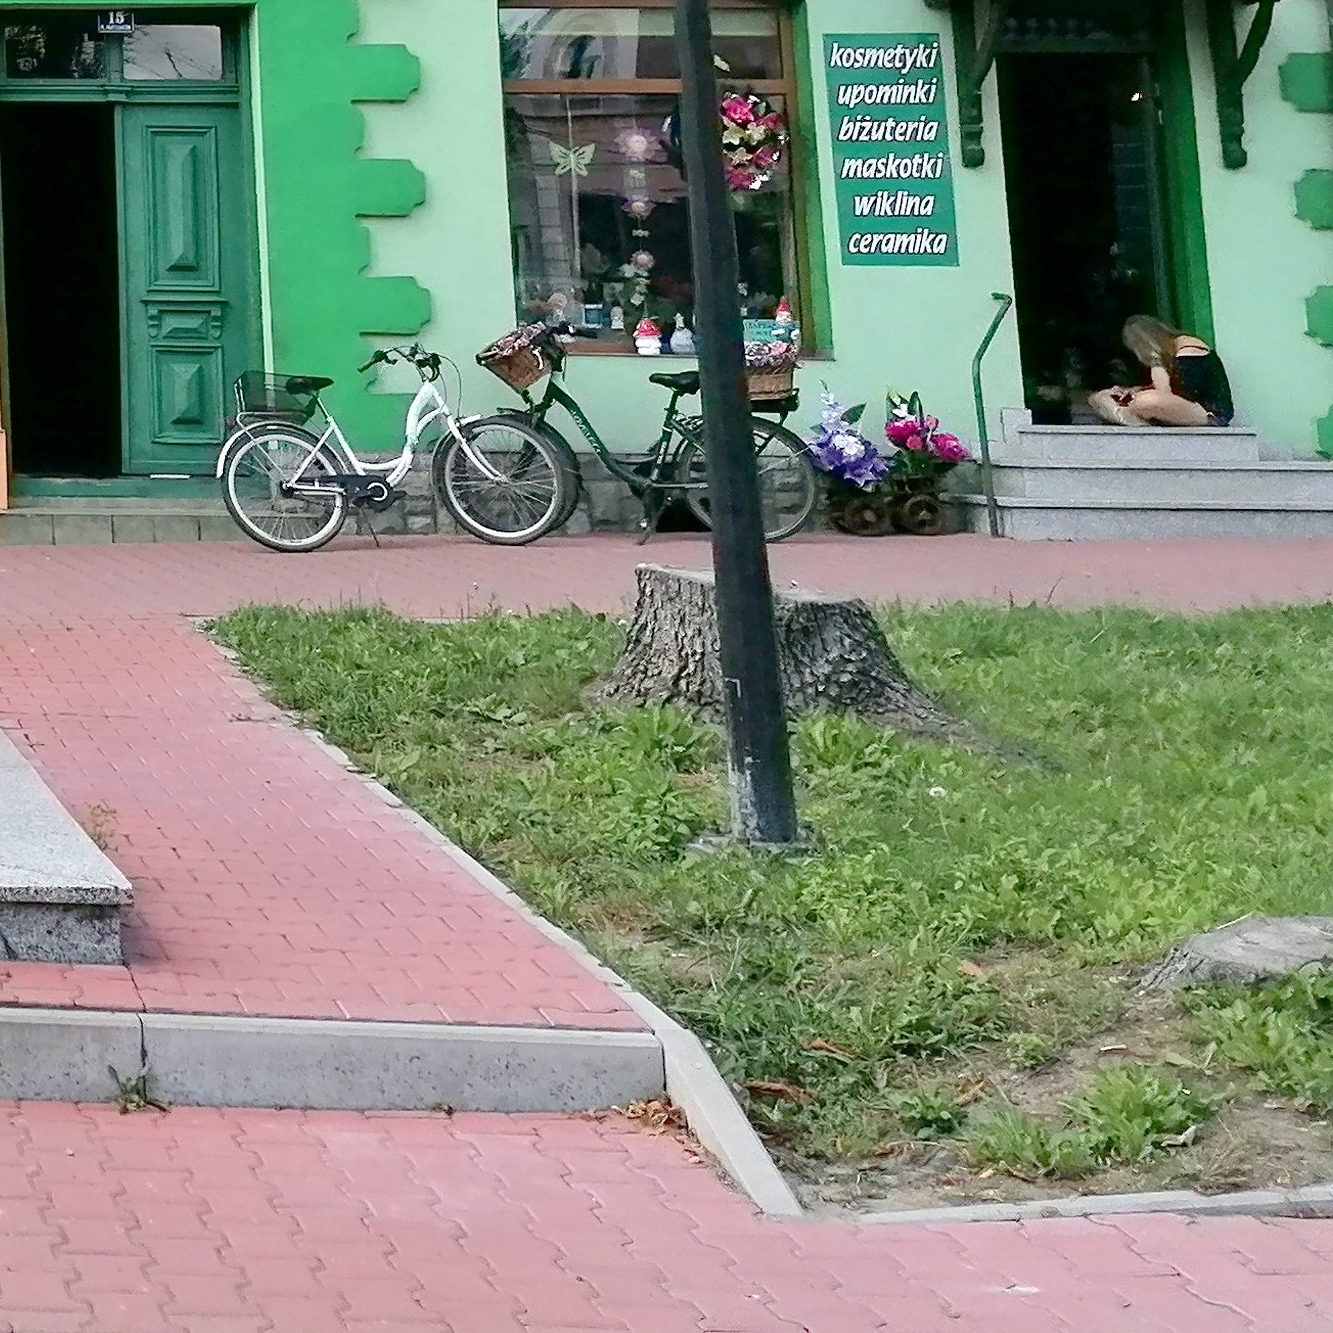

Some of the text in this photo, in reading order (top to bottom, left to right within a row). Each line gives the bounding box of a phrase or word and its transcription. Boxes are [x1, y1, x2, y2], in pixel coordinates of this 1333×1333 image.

[830, 42, 938, 74] kosmetyki
[837, 78, 937, 108] upominki
[838, 115, 938, 141] biżuteria
[841, 152, 943, 178] maskotki
[854, 190, 935, 216] wiklina
[848, 228, 948, 254] ceramika
